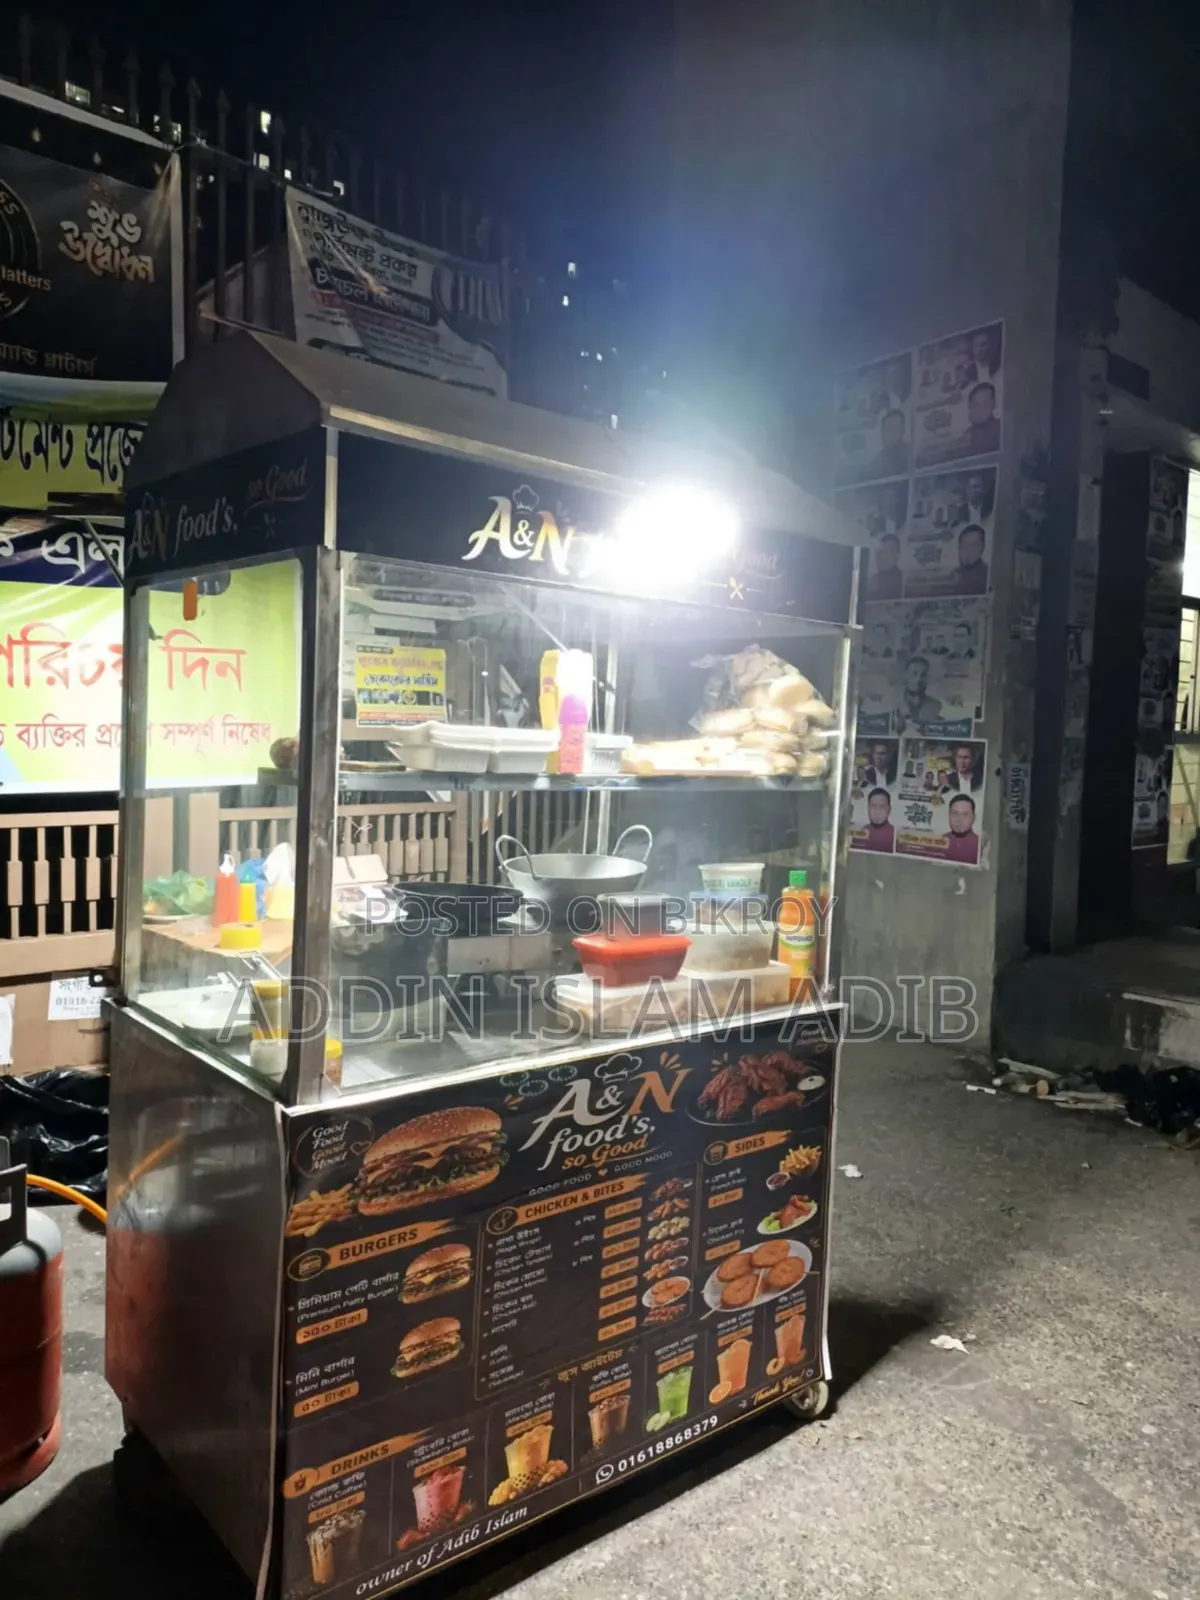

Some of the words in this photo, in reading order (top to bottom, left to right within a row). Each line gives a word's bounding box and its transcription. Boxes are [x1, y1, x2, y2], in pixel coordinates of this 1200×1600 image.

[87, 200, 141, 246] শুভ
[265, 458, 308, 498] Good
[462, 496, 574, 576] A&N
[160, 629, 247, 692] দিন
[15, 713, 87, 750] ব্যক্তির
[160, 714, 215, 754] সম্পূর্ণ
[221, 713, 273, 749] নিষেধ
[518, 1068, 694, 1152] A&N
[311, 1131, 346, 1149] Food
[312, 1120, 349, 1138] Good
[735, 1136, 765, 1153] SIDES
[309, 1151, 348, 1172] Mood
[311, 1141, 346, 1161] Good
[562, 1154, 587, 1170] so
[592, 1134, 648, 1167] Good
[614, 1159, 642, 1173] GOOD
[645, 1150, 673, 1164] MOOD
[525, 1194, 578, 1218] CHICKEN
[581, 1192, 590, 1202] &
[593, 1181, 625, 1199] BITES
[528, 1182, 560, 1197] GOOD
[563, 1173, 592, 1187] FOOD
[339, 1228, 418, 1261] BURGERS
[334, 1312, 362, 1329] টাকা
[324, 1386, 351, 1403] টাকা
[752, 1382, 780, 1405] Thank
[331, 1444, 389, 1475] DRINKS
[616, 1414, 719, 1473] 01618868379
[355, 1559, 413, 1596] owner
[416, 1541, 442, 1568] of
[437, 1524, 480, 1559] Adib
[484, 1504, 528, 1535] Islam
